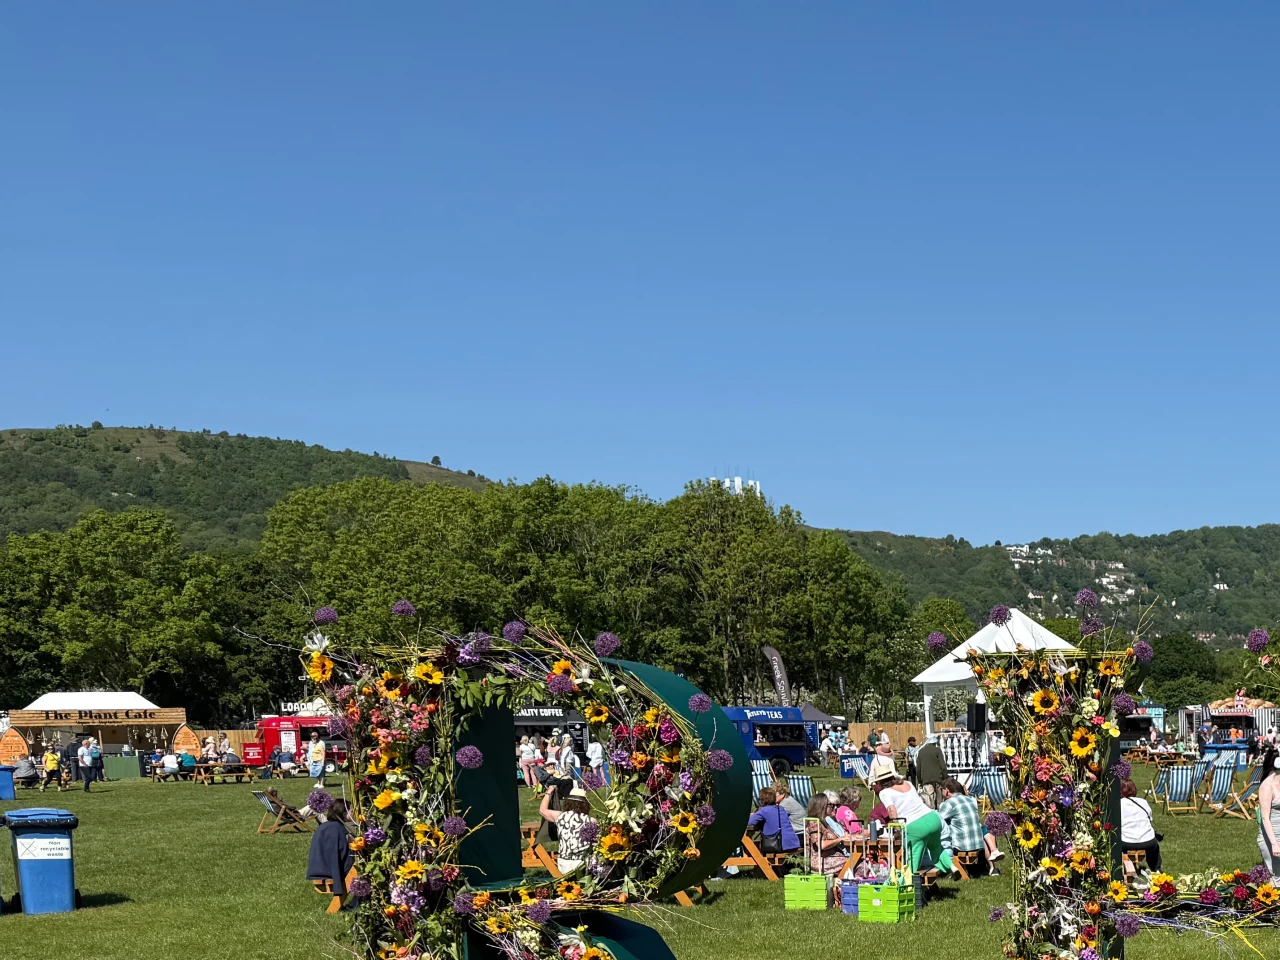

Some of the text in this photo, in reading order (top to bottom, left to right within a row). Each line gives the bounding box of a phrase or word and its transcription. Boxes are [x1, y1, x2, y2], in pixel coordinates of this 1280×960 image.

[772, 656, 791, 707] Greek Souvla
[41, 709, 156, 720] The Plant Cafe
[539, 708, 564, 717] COFFEE
[766, 710, 784, 719] TEAS
